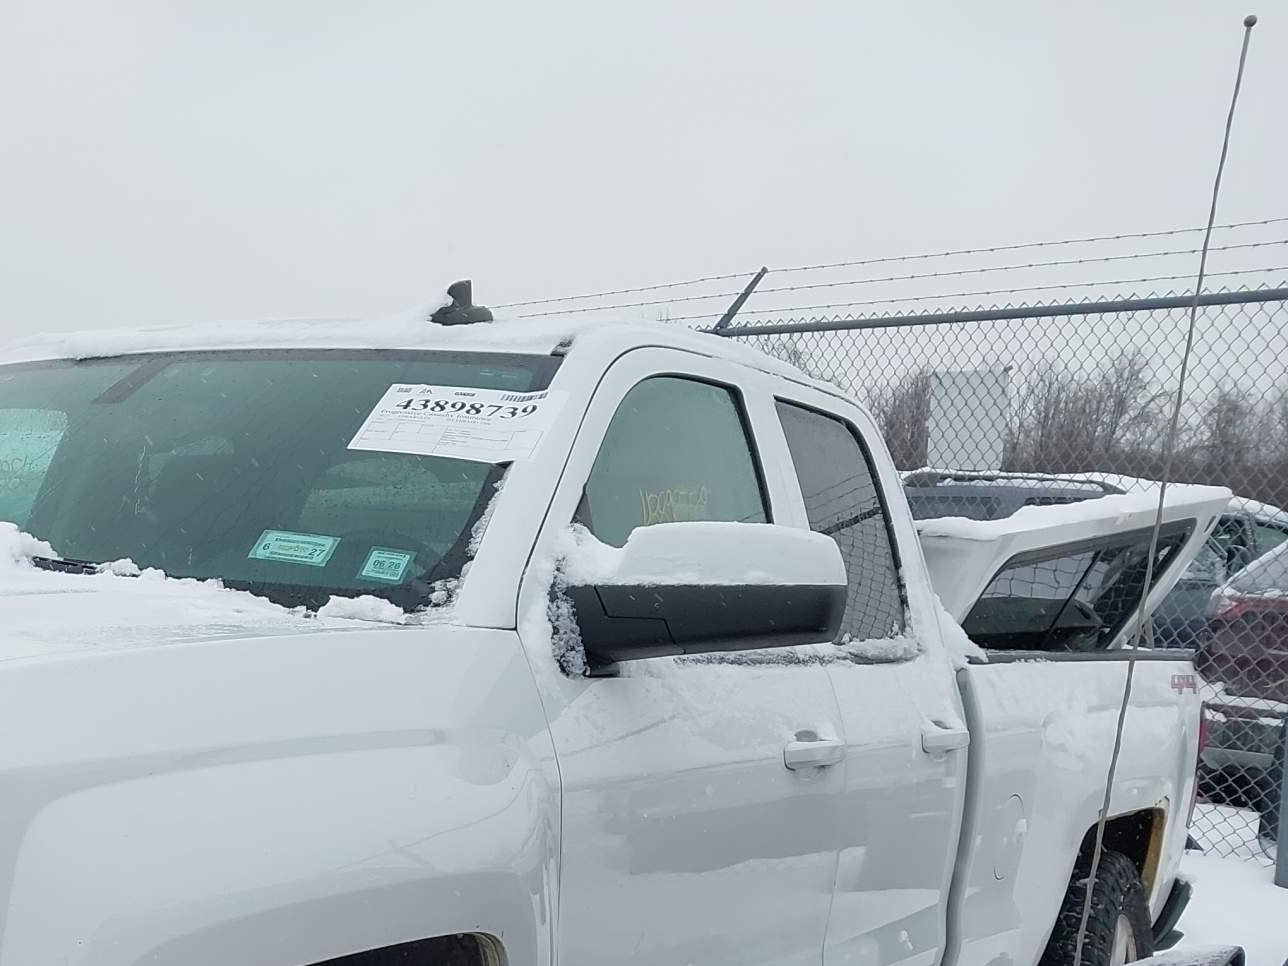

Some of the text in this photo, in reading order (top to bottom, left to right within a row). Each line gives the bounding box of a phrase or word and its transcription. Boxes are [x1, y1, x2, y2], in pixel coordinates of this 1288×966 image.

[396, 398, 538, 419] 43898739
[309, 547, 325, 558] 27
[372, 559, 385, 568] 06
